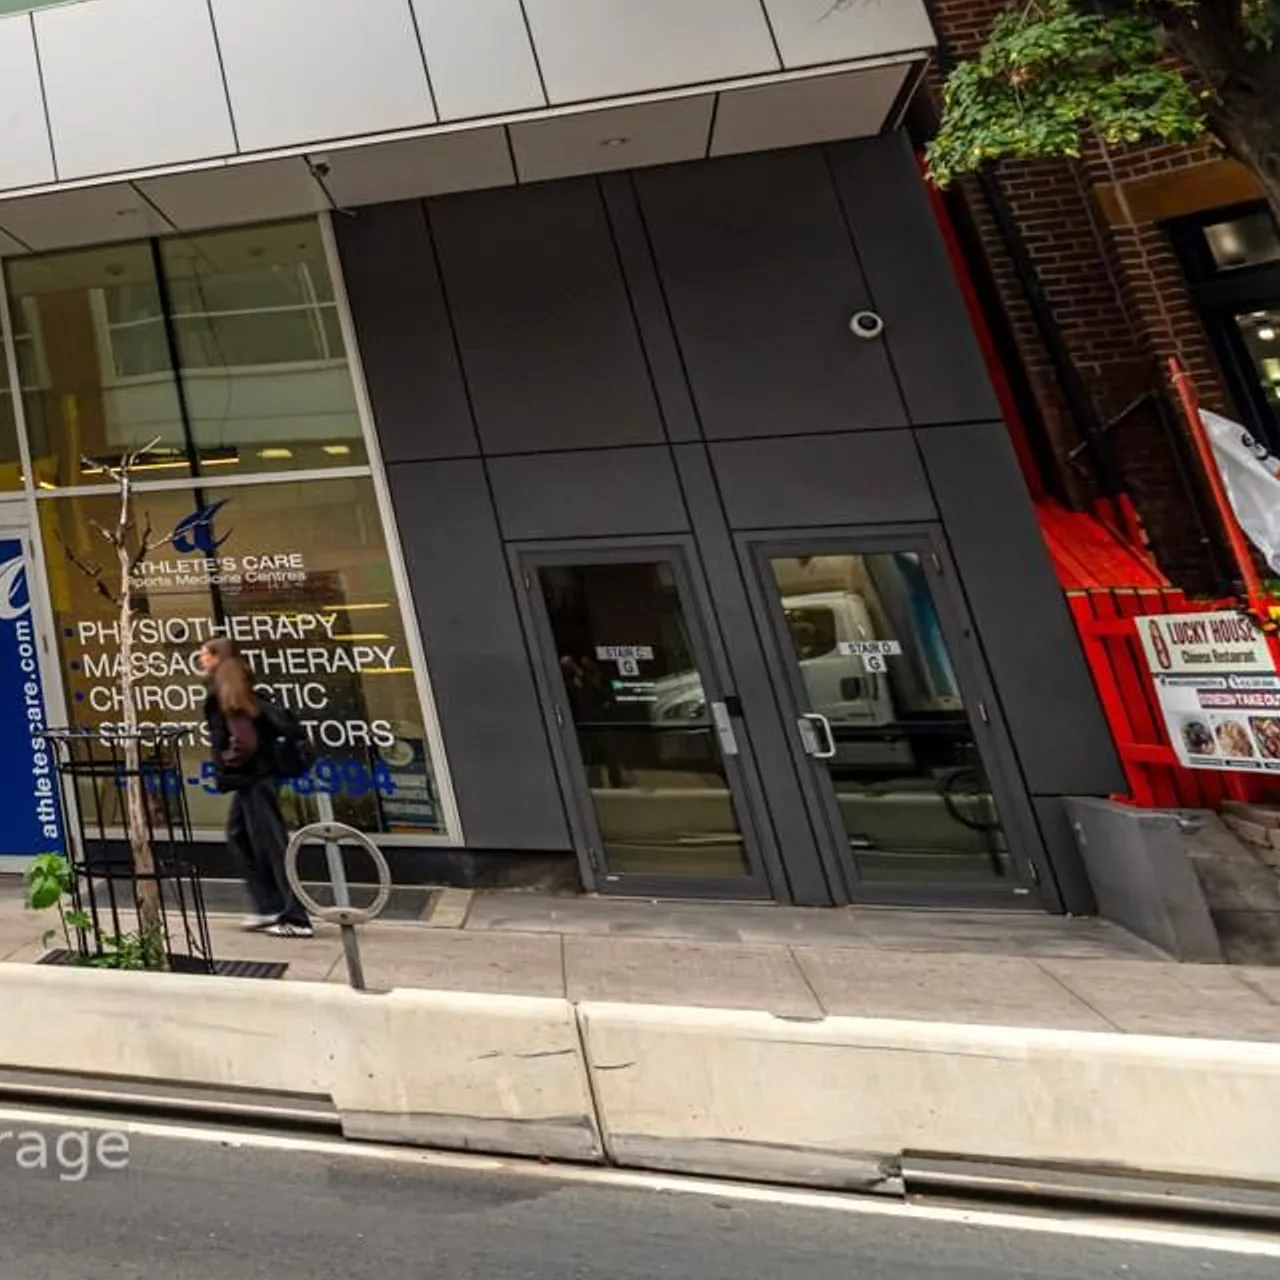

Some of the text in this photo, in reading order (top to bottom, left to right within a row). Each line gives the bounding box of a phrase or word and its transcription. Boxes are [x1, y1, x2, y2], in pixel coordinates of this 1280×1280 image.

[132, 554, 305, 576] THLETE'S CARE
[175, 572, 241, 587] Medicine
[245, 570, 307, 584] Centres
[1166, 617, 1257, 645] LUCKY HOUSE
[82, 646, 396, 678] MASSA THERAPY
[868, 657, 881, 670] G
[89, 682, 329, 712] CHIROPTIC
[15, 620, 59, 839] athletescare.com
